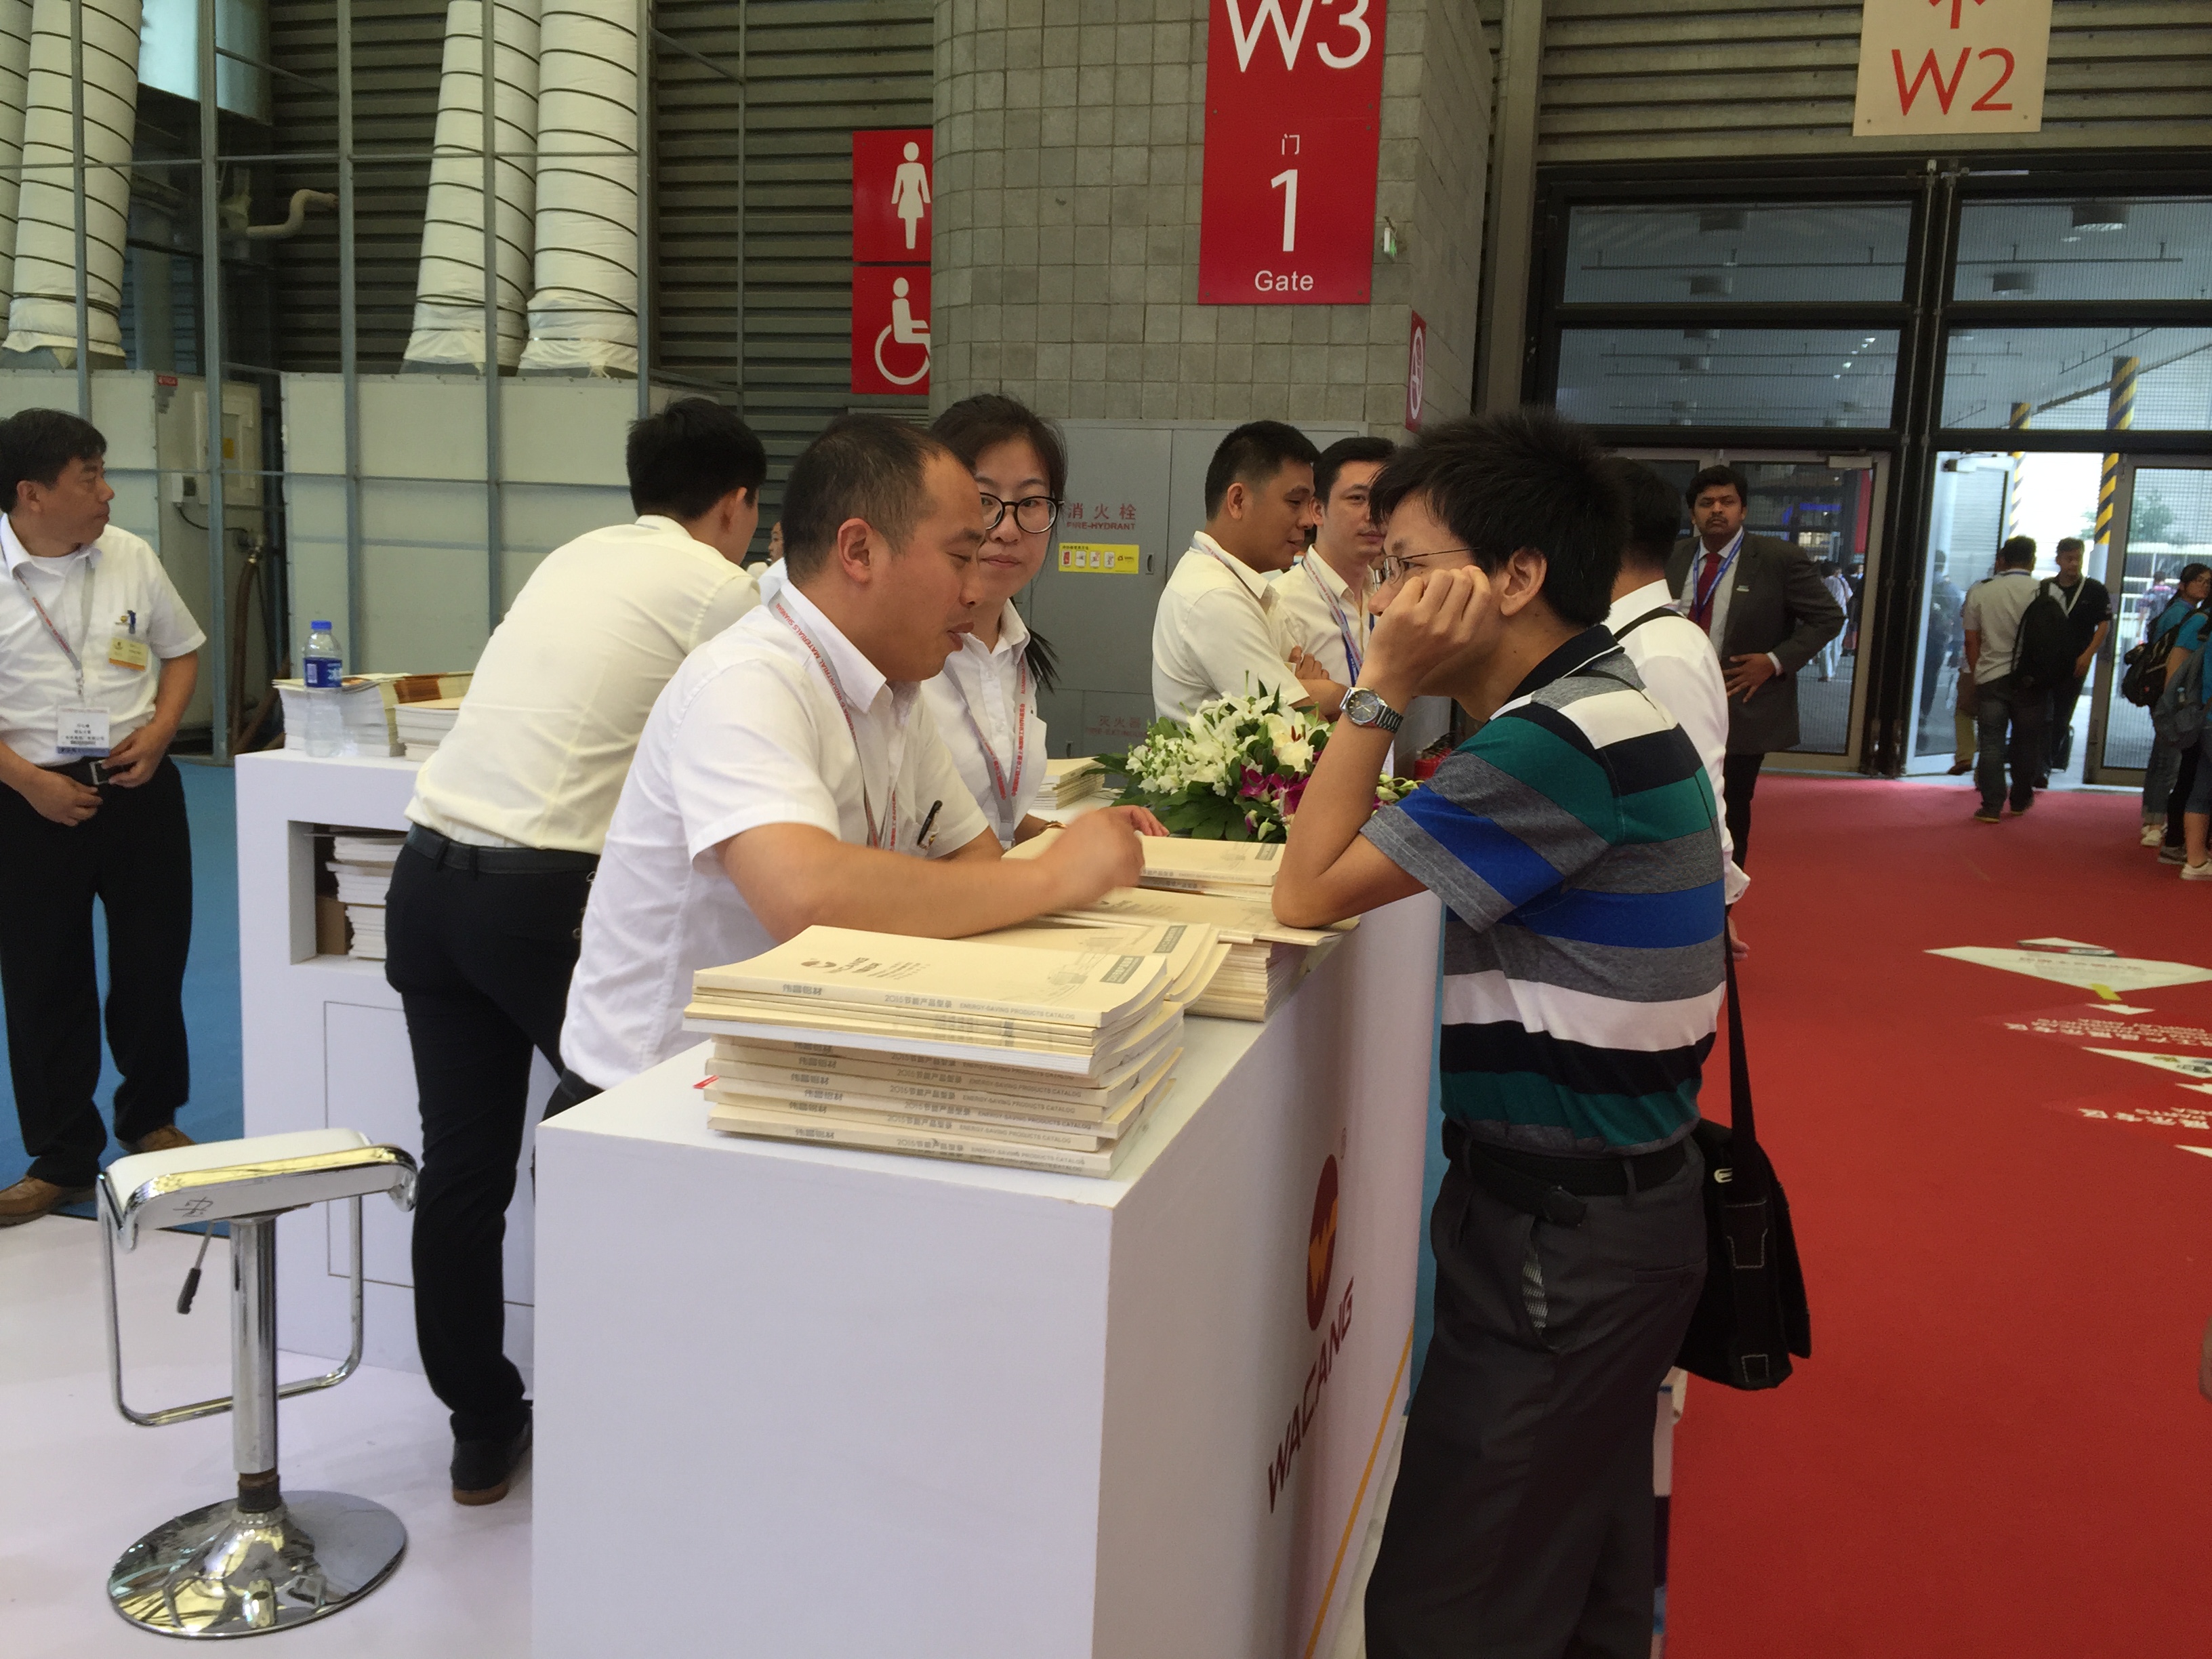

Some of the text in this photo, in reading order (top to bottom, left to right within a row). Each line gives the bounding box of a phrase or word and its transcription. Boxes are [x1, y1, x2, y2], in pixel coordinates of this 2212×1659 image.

[1226, 0, 1372, 73] W3
[1891, 47, 2015, 116] W2
[1281, 134, 1300, 155] 门
[1271, 169, 1298, 252] 1
[1254, 270, 1314, 292] Gate
[1067, 502, 1137, 520] 消火栓
[1066, 521, 1136, 531] FIRE-HYDRANT
[791, 623, 822, 659] MATERIALS
[959, 1002, 1074, 1019] ENERGY-SAVING PRODUCTS CATALOG
[1268, 1275, 1354, 1514] WACANG
